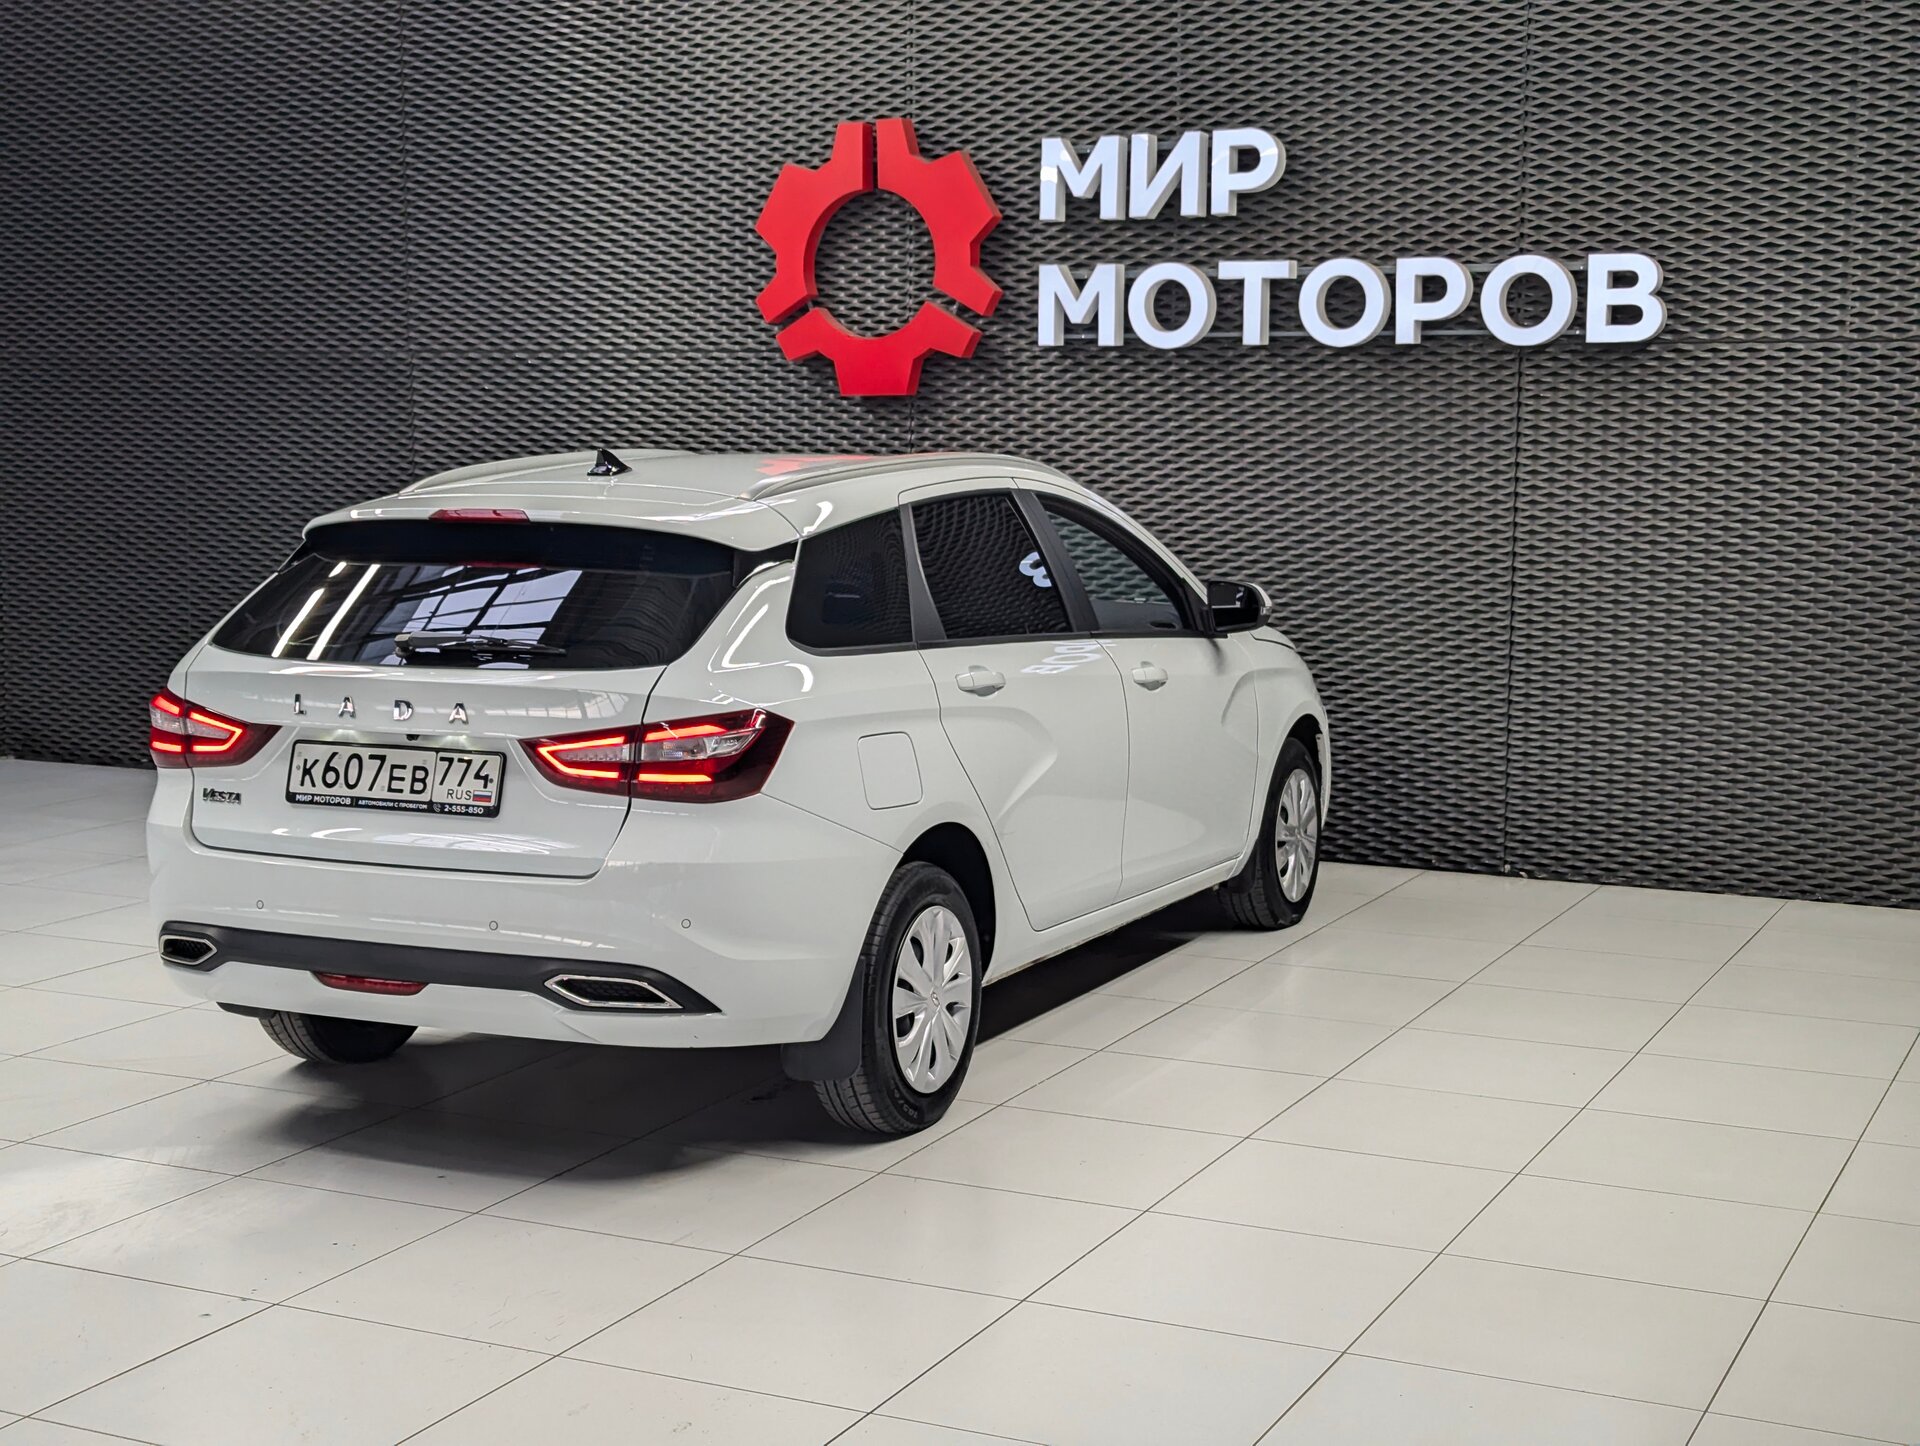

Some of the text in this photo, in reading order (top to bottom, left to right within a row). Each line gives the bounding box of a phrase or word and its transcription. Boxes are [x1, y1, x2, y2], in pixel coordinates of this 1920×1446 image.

[1039, 127, 1287, 222] МИР
[1037, 252, 1668, 350] МОТОРОВ
[293, 694, 469, 724] LADA
[438, 756, 490, 789] 774
[203, 787, 242, 805] VESTA
[295, 794, 351, 805] МИР МОТОРОВ
[446, 789, 472, 801] RUS
[444, 805, 484, 814] 2-555-850
